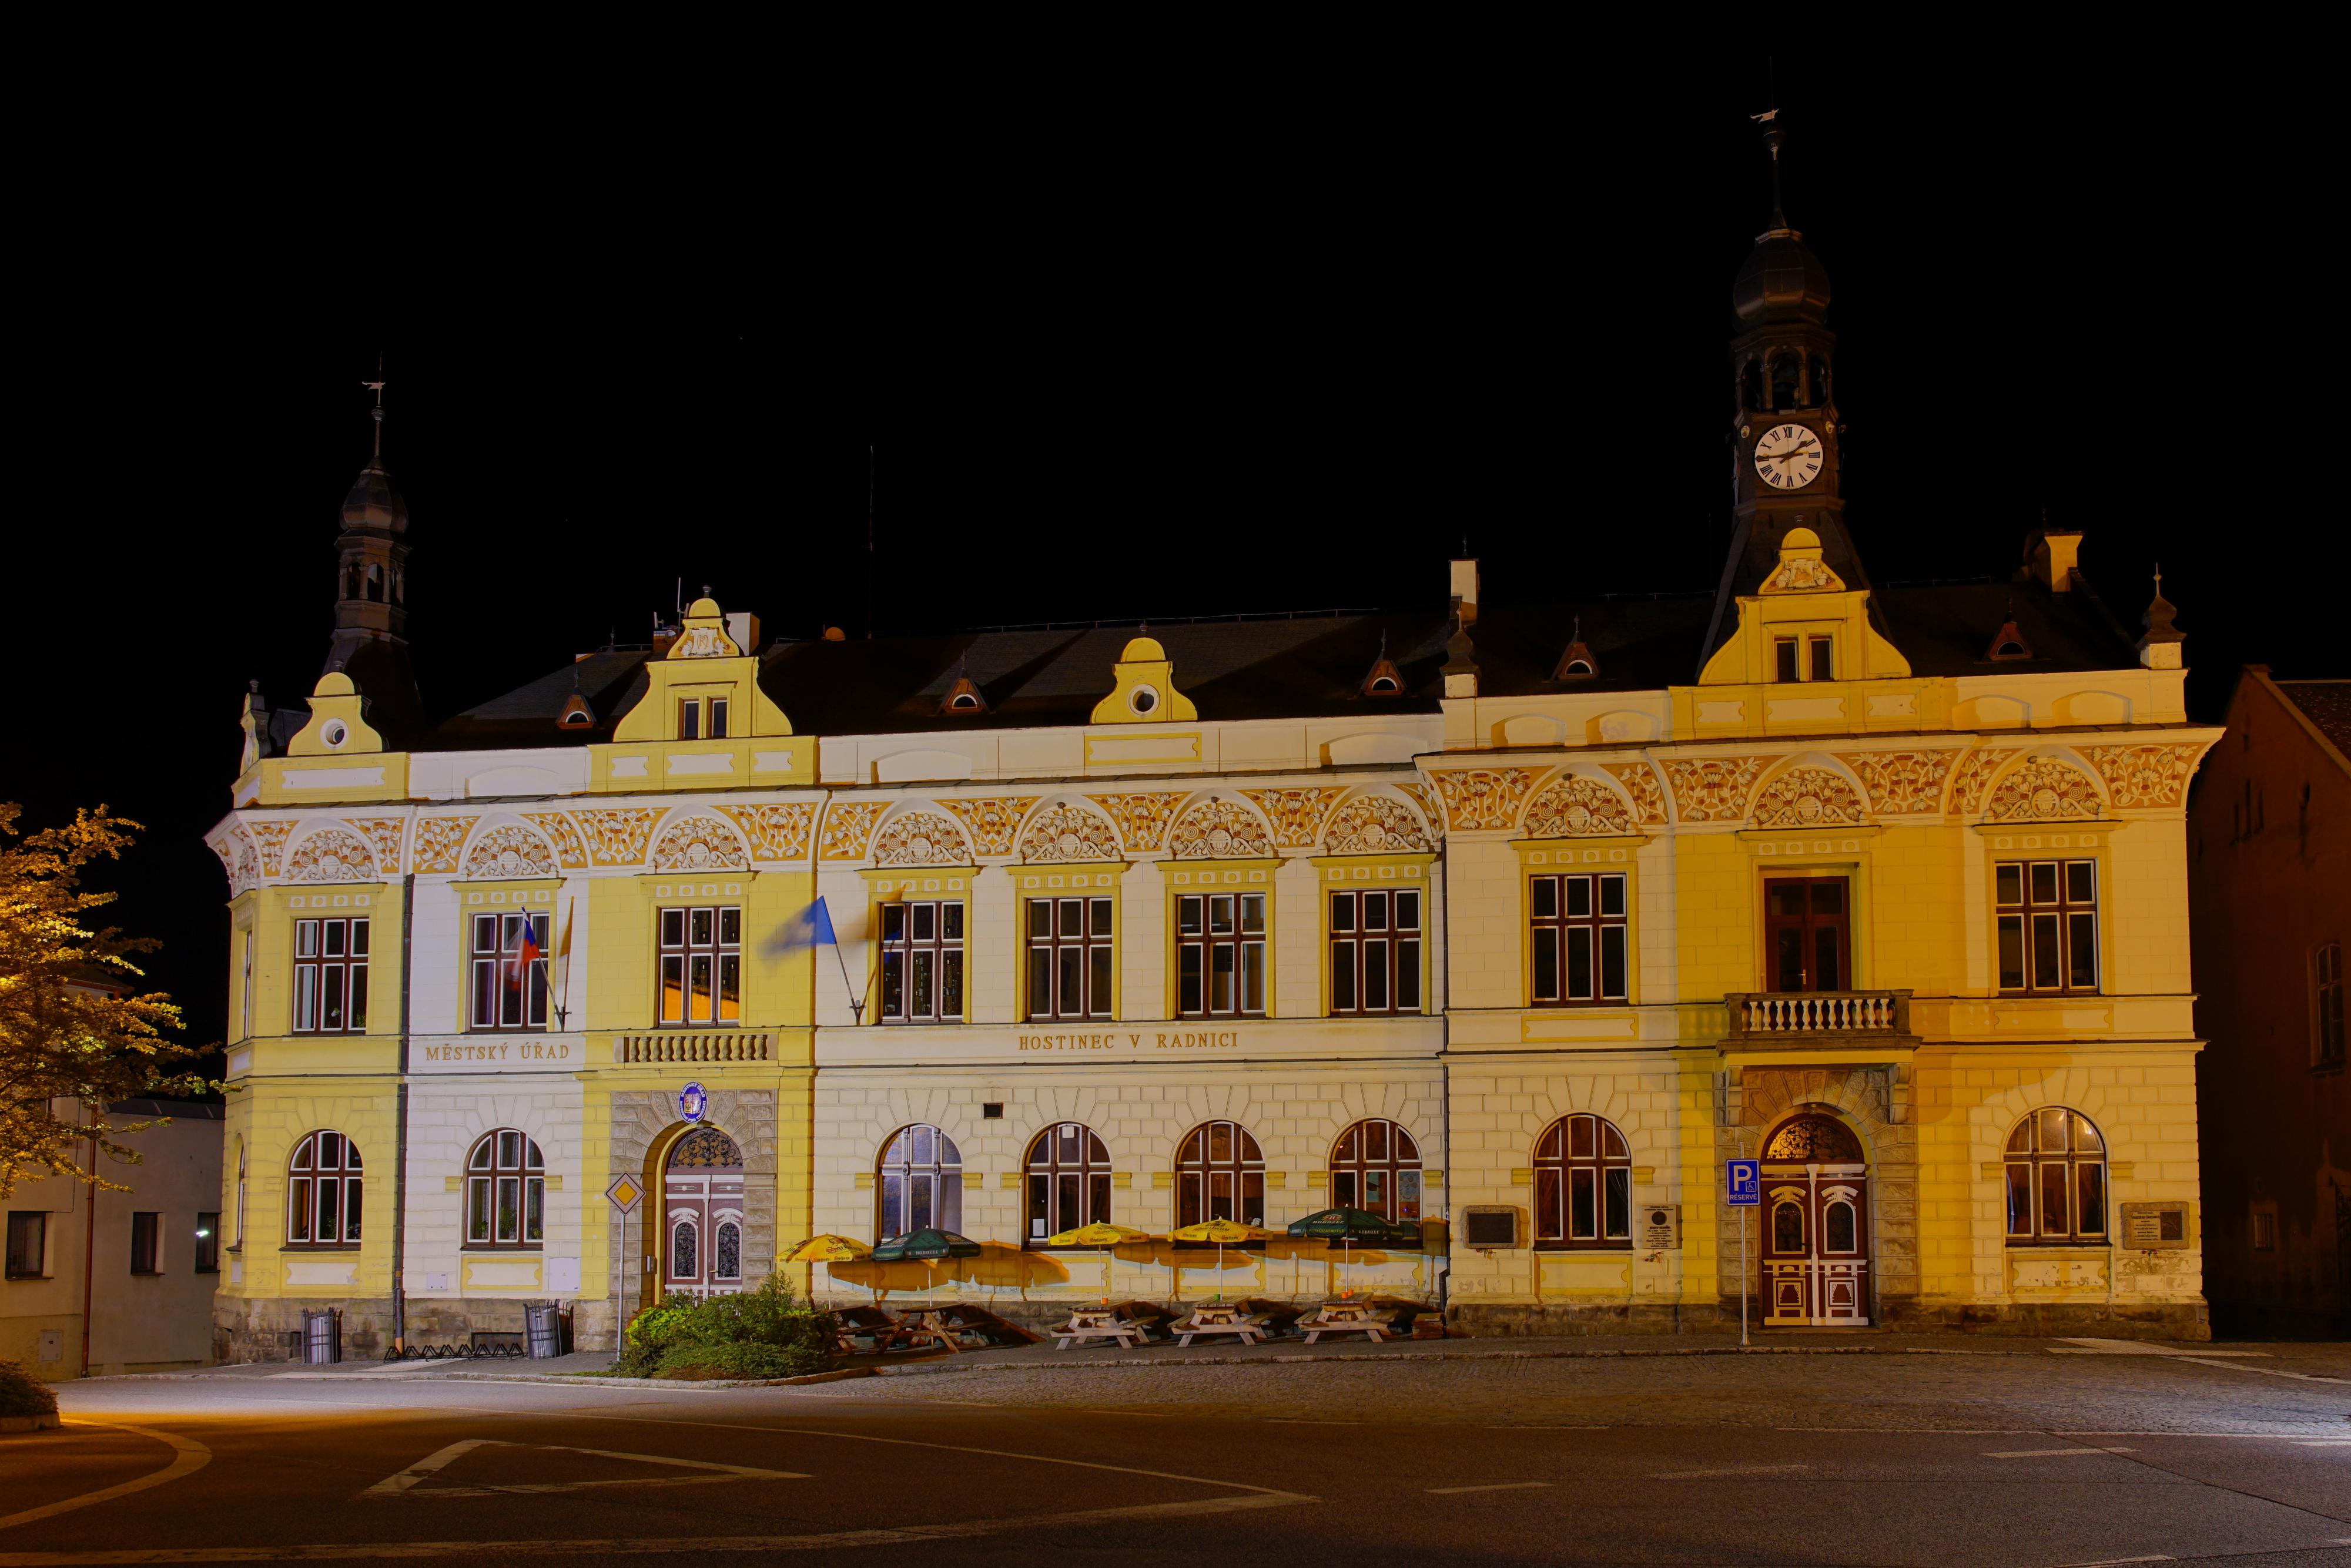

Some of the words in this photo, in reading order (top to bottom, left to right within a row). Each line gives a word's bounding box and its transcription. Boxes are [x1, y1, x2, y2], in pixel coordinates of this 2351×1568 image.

[1769, 430, 1781, 443] XI
[1783, 427, 1793, 438] XII
[1797, 429, 1804, 440] I
[1760, 441, 1772, 450] X
[1019, 1034, 1114, 1050] HOSTINEC
[1129, 1034, 1141, 1048] V
[1157, 1032, 1238, 1048] RADNICI
[426, 1042, 508, 1061] MĚSTSKÝ
[520, 1041, 570, 1059] ÚŘAD
[1733, 1165, 1752, 1191] P
